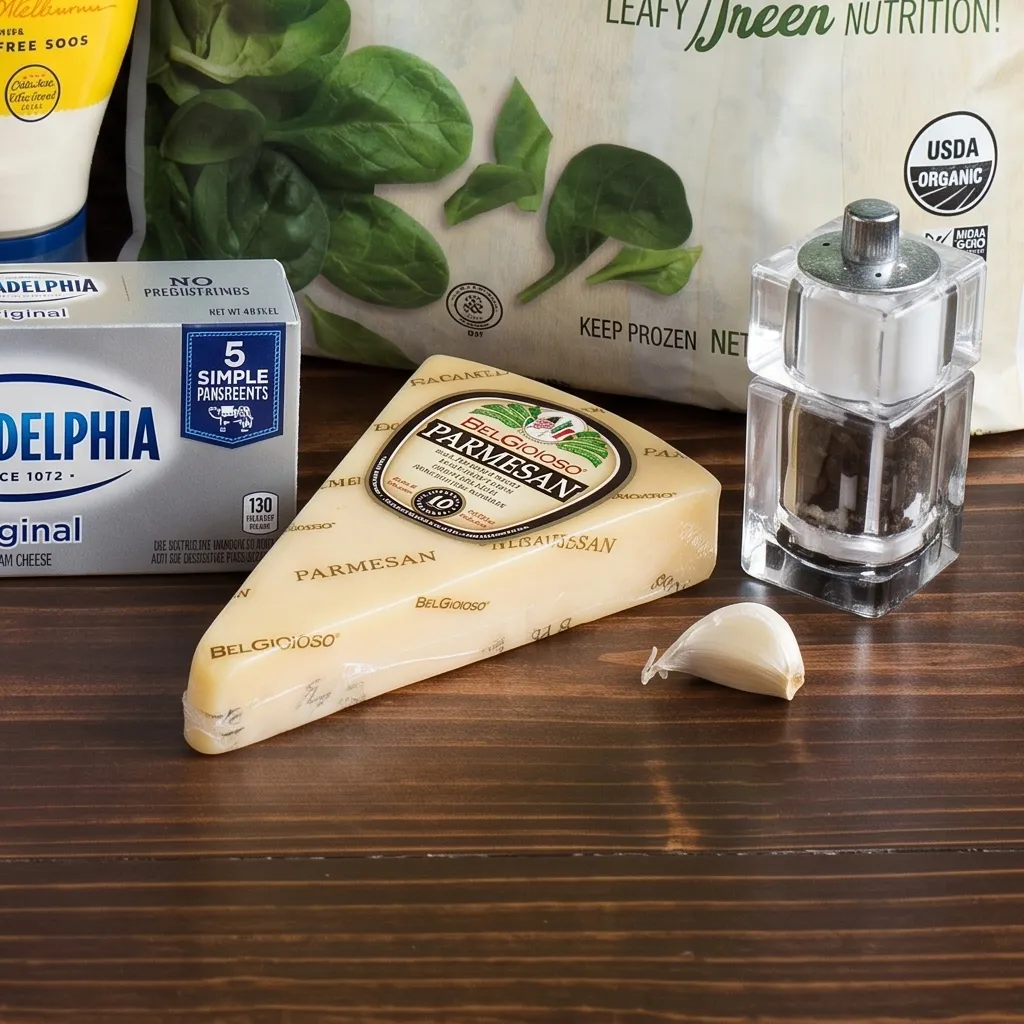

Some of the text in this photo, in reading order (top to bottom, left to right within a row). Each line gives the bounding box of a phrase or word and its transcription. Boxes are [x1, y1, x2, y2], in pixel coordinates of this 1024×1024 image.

[928, 138, 979, 160] USDA
[918, 167, 983, 188] ORGANIC
[169, 277, 213, 286] NO
[580, 316, 622, 340] KEEP
[628, 322, 697, 351] PROZEN
[224, 341, 246, 368] 5
[197, 369, 269, 385] SIMPLE
[197, 386, 268, 401] PANSREENTS
[421, 422, 583, 499] PARMESAN
[26, 471, 63, 482] 1072
[249, 497, 273, 513] 130
[16, 553, 52, 567] CHEESE
[294, 550, 437, 582] PARMESAN
